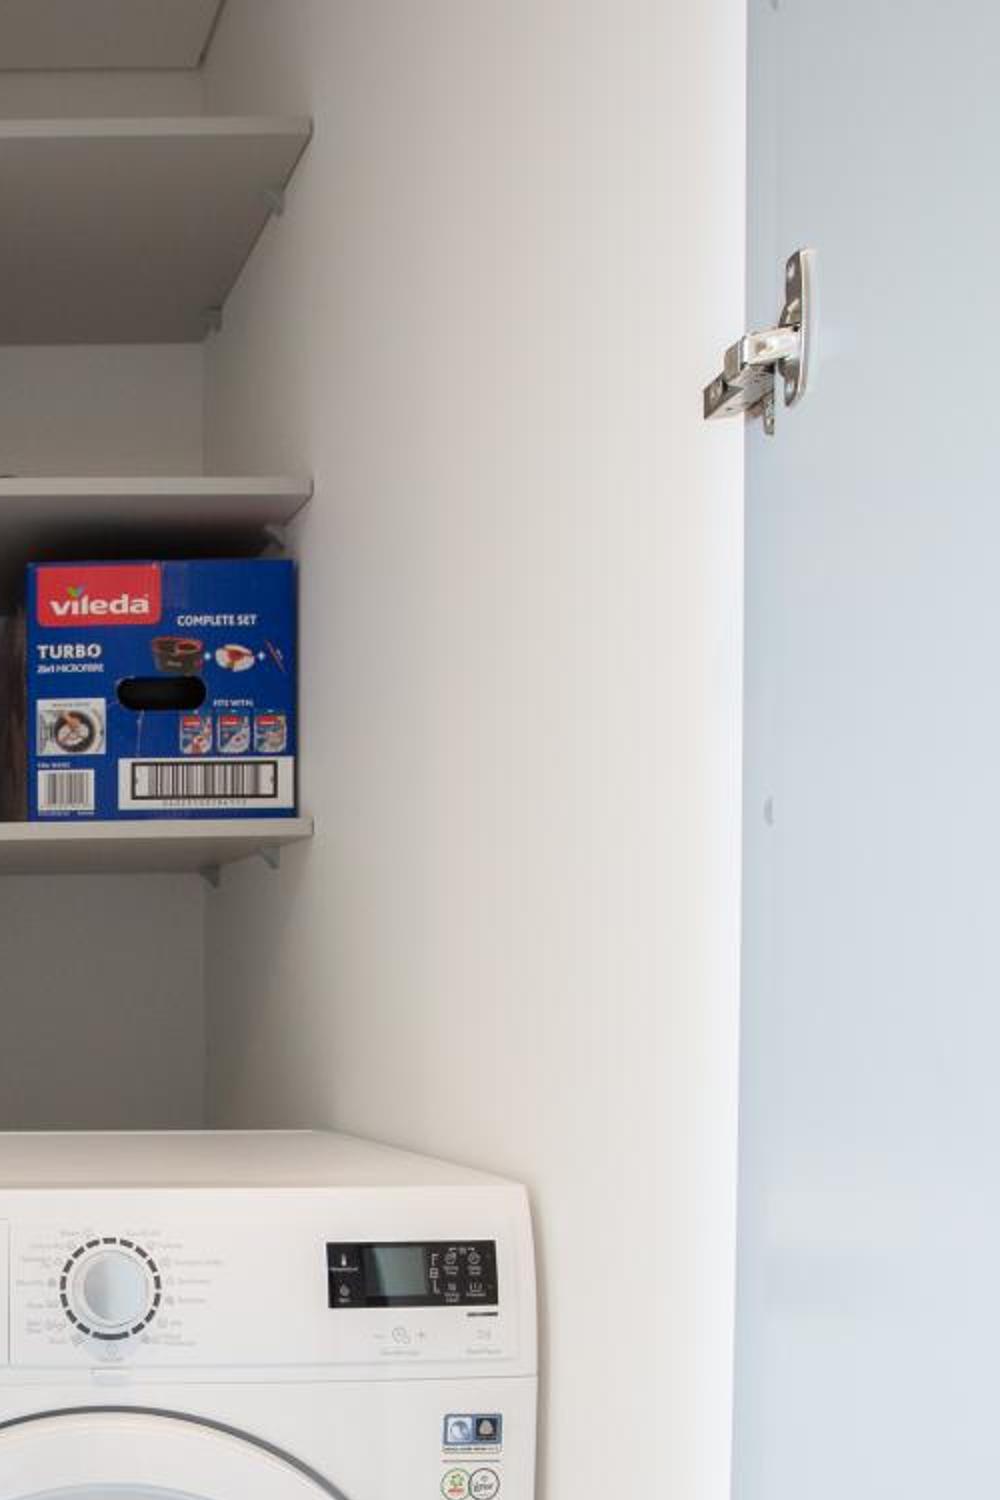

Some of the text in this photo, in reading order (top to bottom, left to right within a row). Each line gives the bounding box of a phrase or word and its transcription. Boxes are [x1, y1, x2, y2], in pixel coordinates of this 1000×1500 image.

[50, 594, 149, 616] vileda
[176, 614, 258, 627] COMPLETE SET
[36, 644, 102, 659] TURBO
